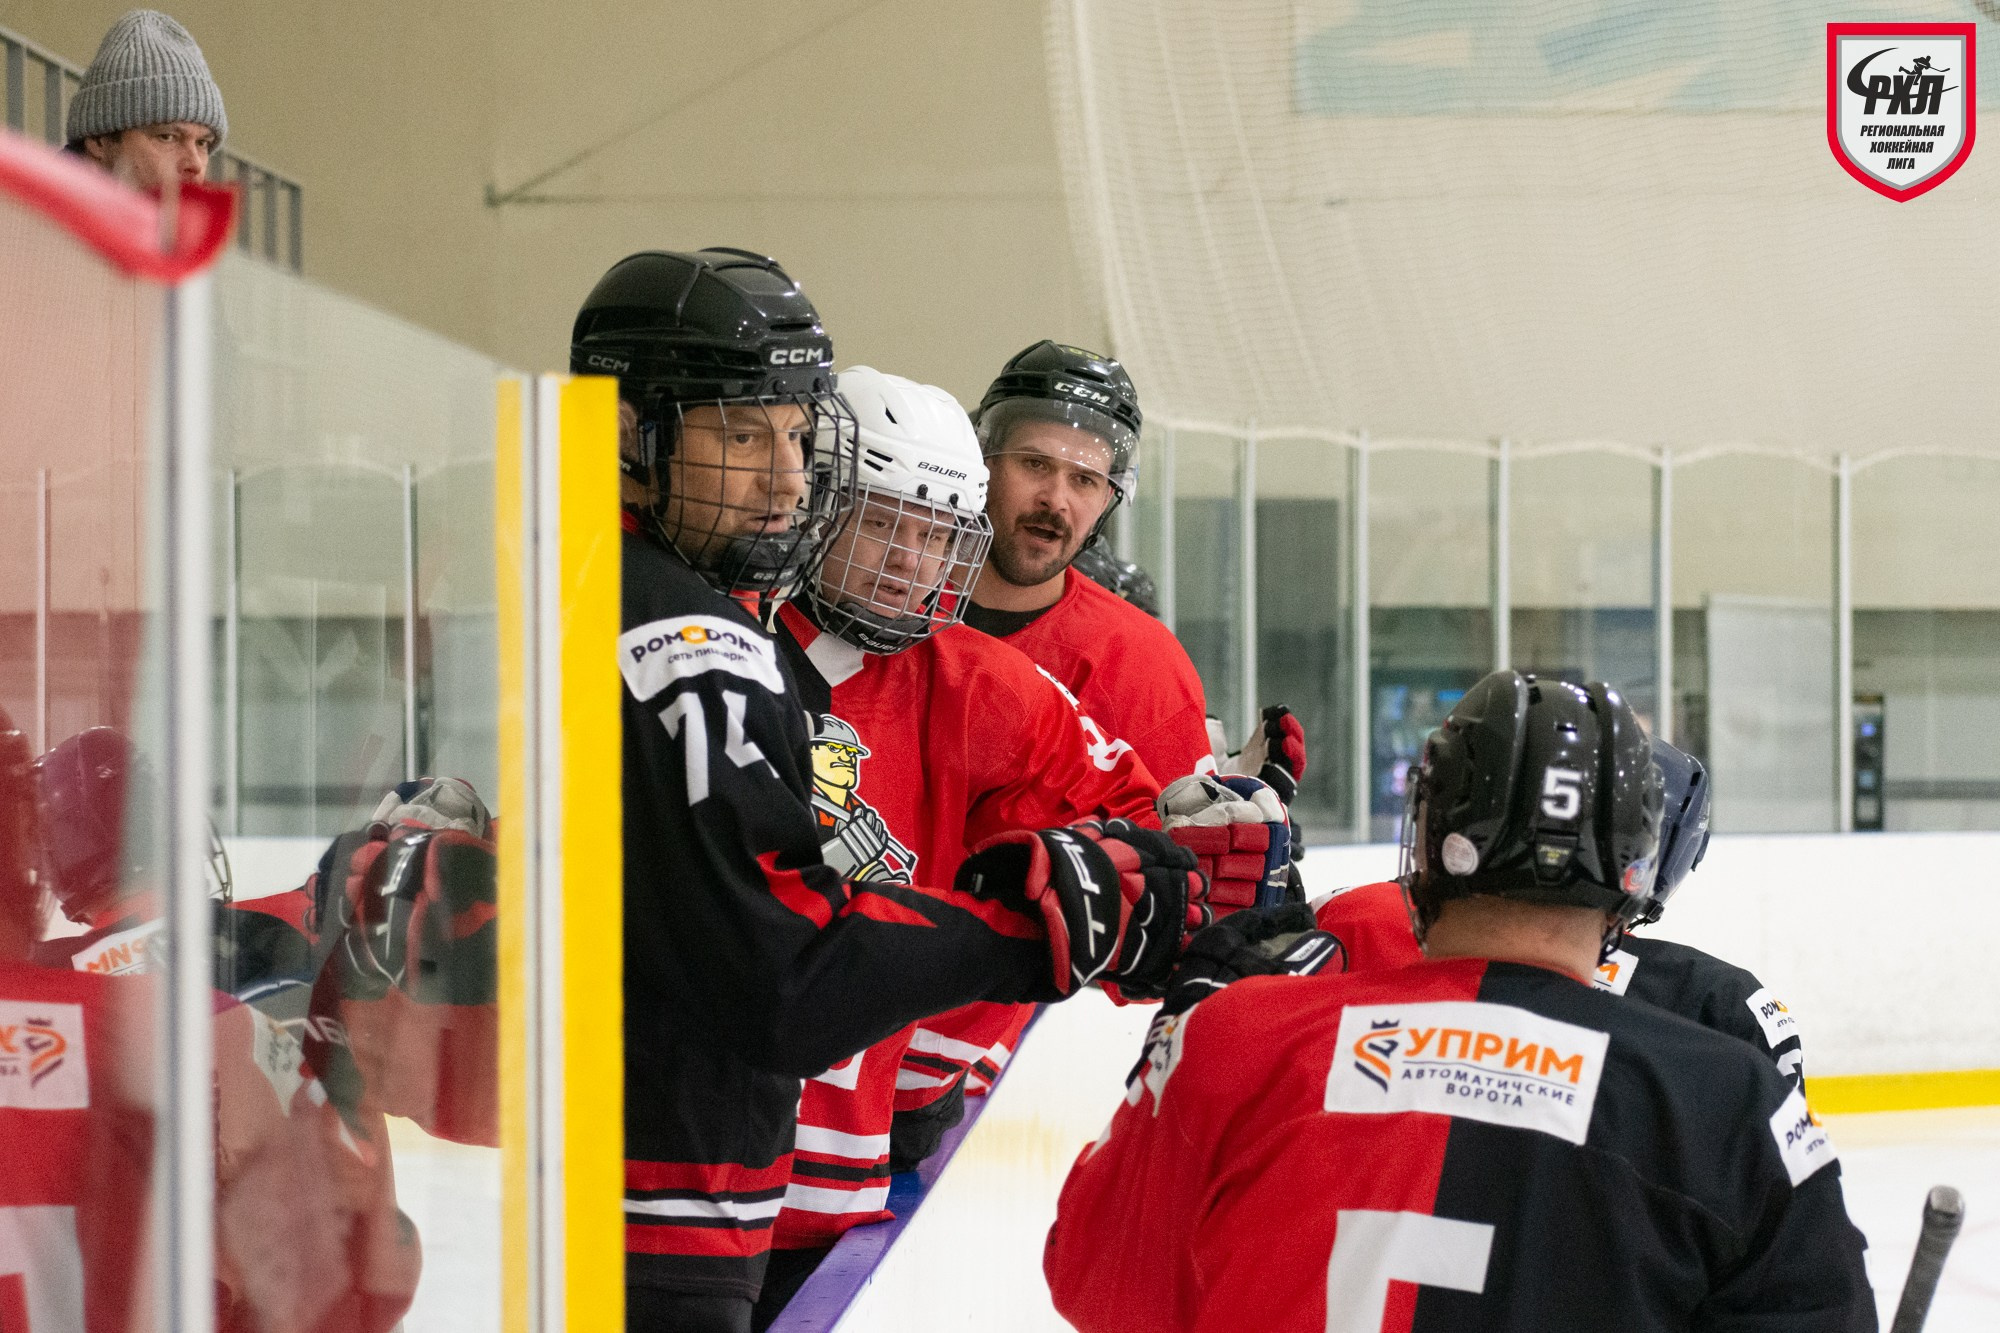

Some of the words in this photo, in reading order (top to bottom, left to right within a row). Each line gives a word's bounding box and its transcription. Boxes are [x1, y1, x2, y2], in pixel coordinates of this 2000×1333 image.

[588, 354, 630, 372] CCM
[769, 348, 824, 365] CCM
[1054, 381, 1110, 404] CCM
[668, 652, 693, 664] сеть
[1541, 767, 1582, 819] 5
[1404, 1028, 1583, 1084] УПРИМ
[1402, 1068, 1575, 1106] АВТОМАТИЧСКИЕ
[1446, 1083, 1523, 1107] ВОРОТА
